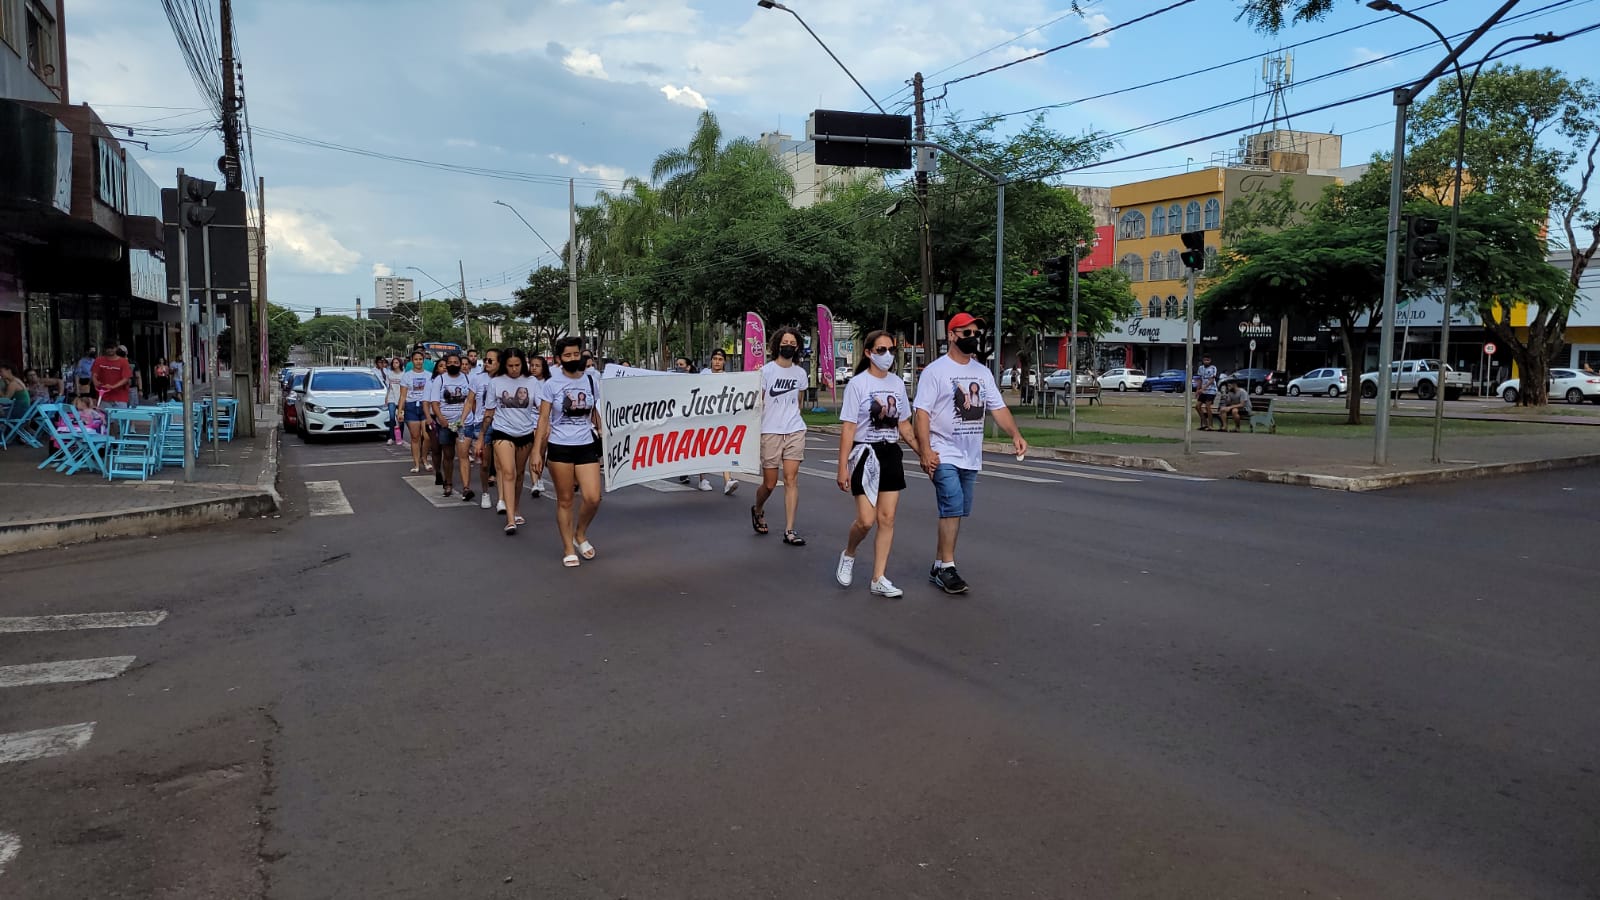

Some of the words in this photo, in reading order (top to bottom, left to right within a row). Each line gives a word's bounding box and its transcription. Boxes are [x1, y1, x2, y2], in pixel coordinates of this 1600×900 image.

[773, 378, 798, 390] NIKE
[605, 398, 676, 436] Queremos
[682, 385, 759, 418] Justiça
[607, 434, 631, 479] PELA
[631, 424, 747, 471] AMANDA
